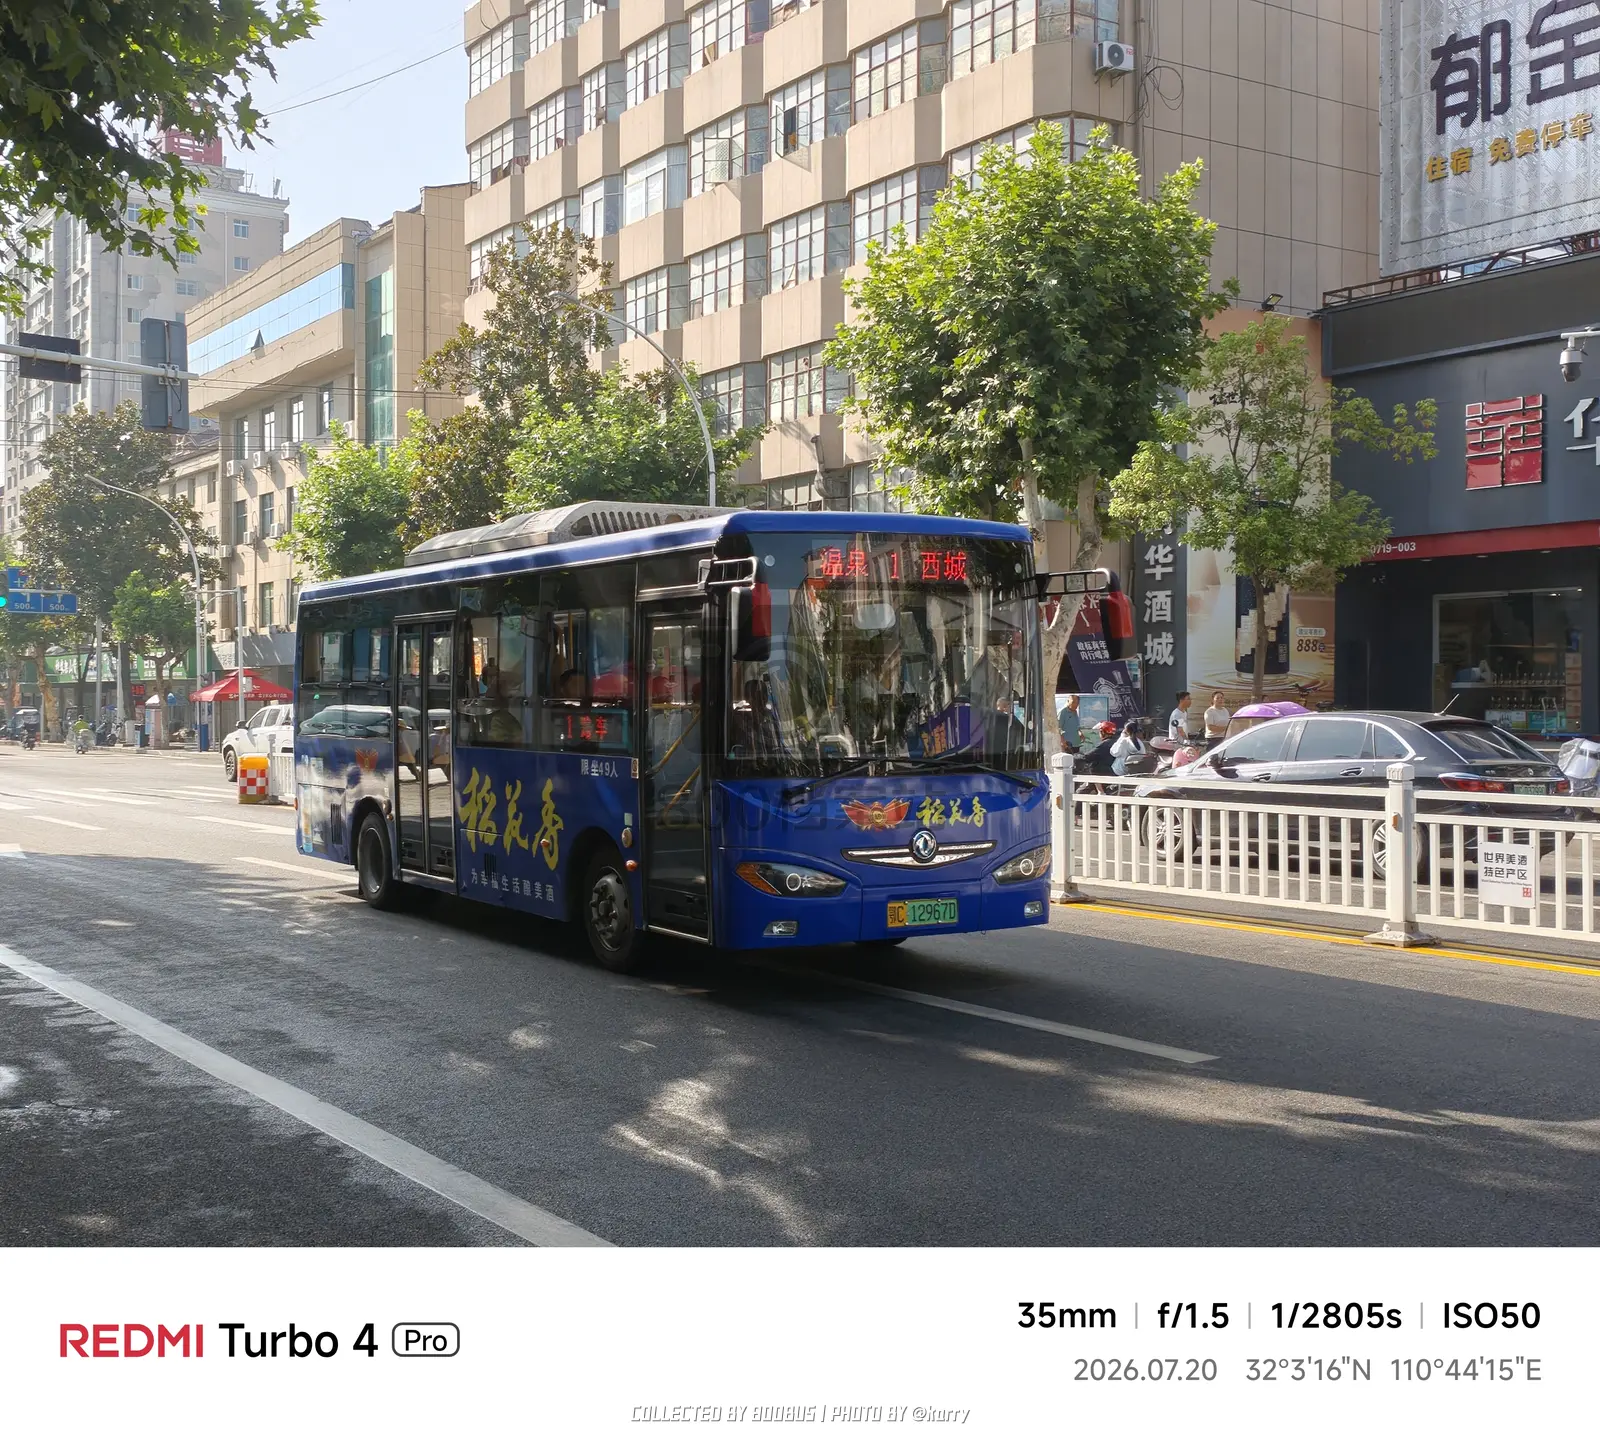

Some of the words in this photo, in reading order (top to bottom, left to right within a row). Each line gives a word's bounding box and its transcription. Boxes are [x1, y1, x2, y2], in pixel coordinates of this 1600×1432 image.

[1425, 147, 1473, 182] 住宿
[1488, 112, 1593, 166] 免费停车
[819, 547, 869, 580] 温泉
[890, 552, 900, 580] 1
[920, 550, 968, 582] 西城
[14, 602, 30, 610] 500
[49, 603, 65, 611] 500
[1143, 517, 1175, 667] 华酒城
[460, 768, 564, 870] 稻花香
[915, 796, 987, 828] 稻花香
[1483, 851, 1528, 866] 世界美酒
[1483, 866, 1528, 880] 特色产区
